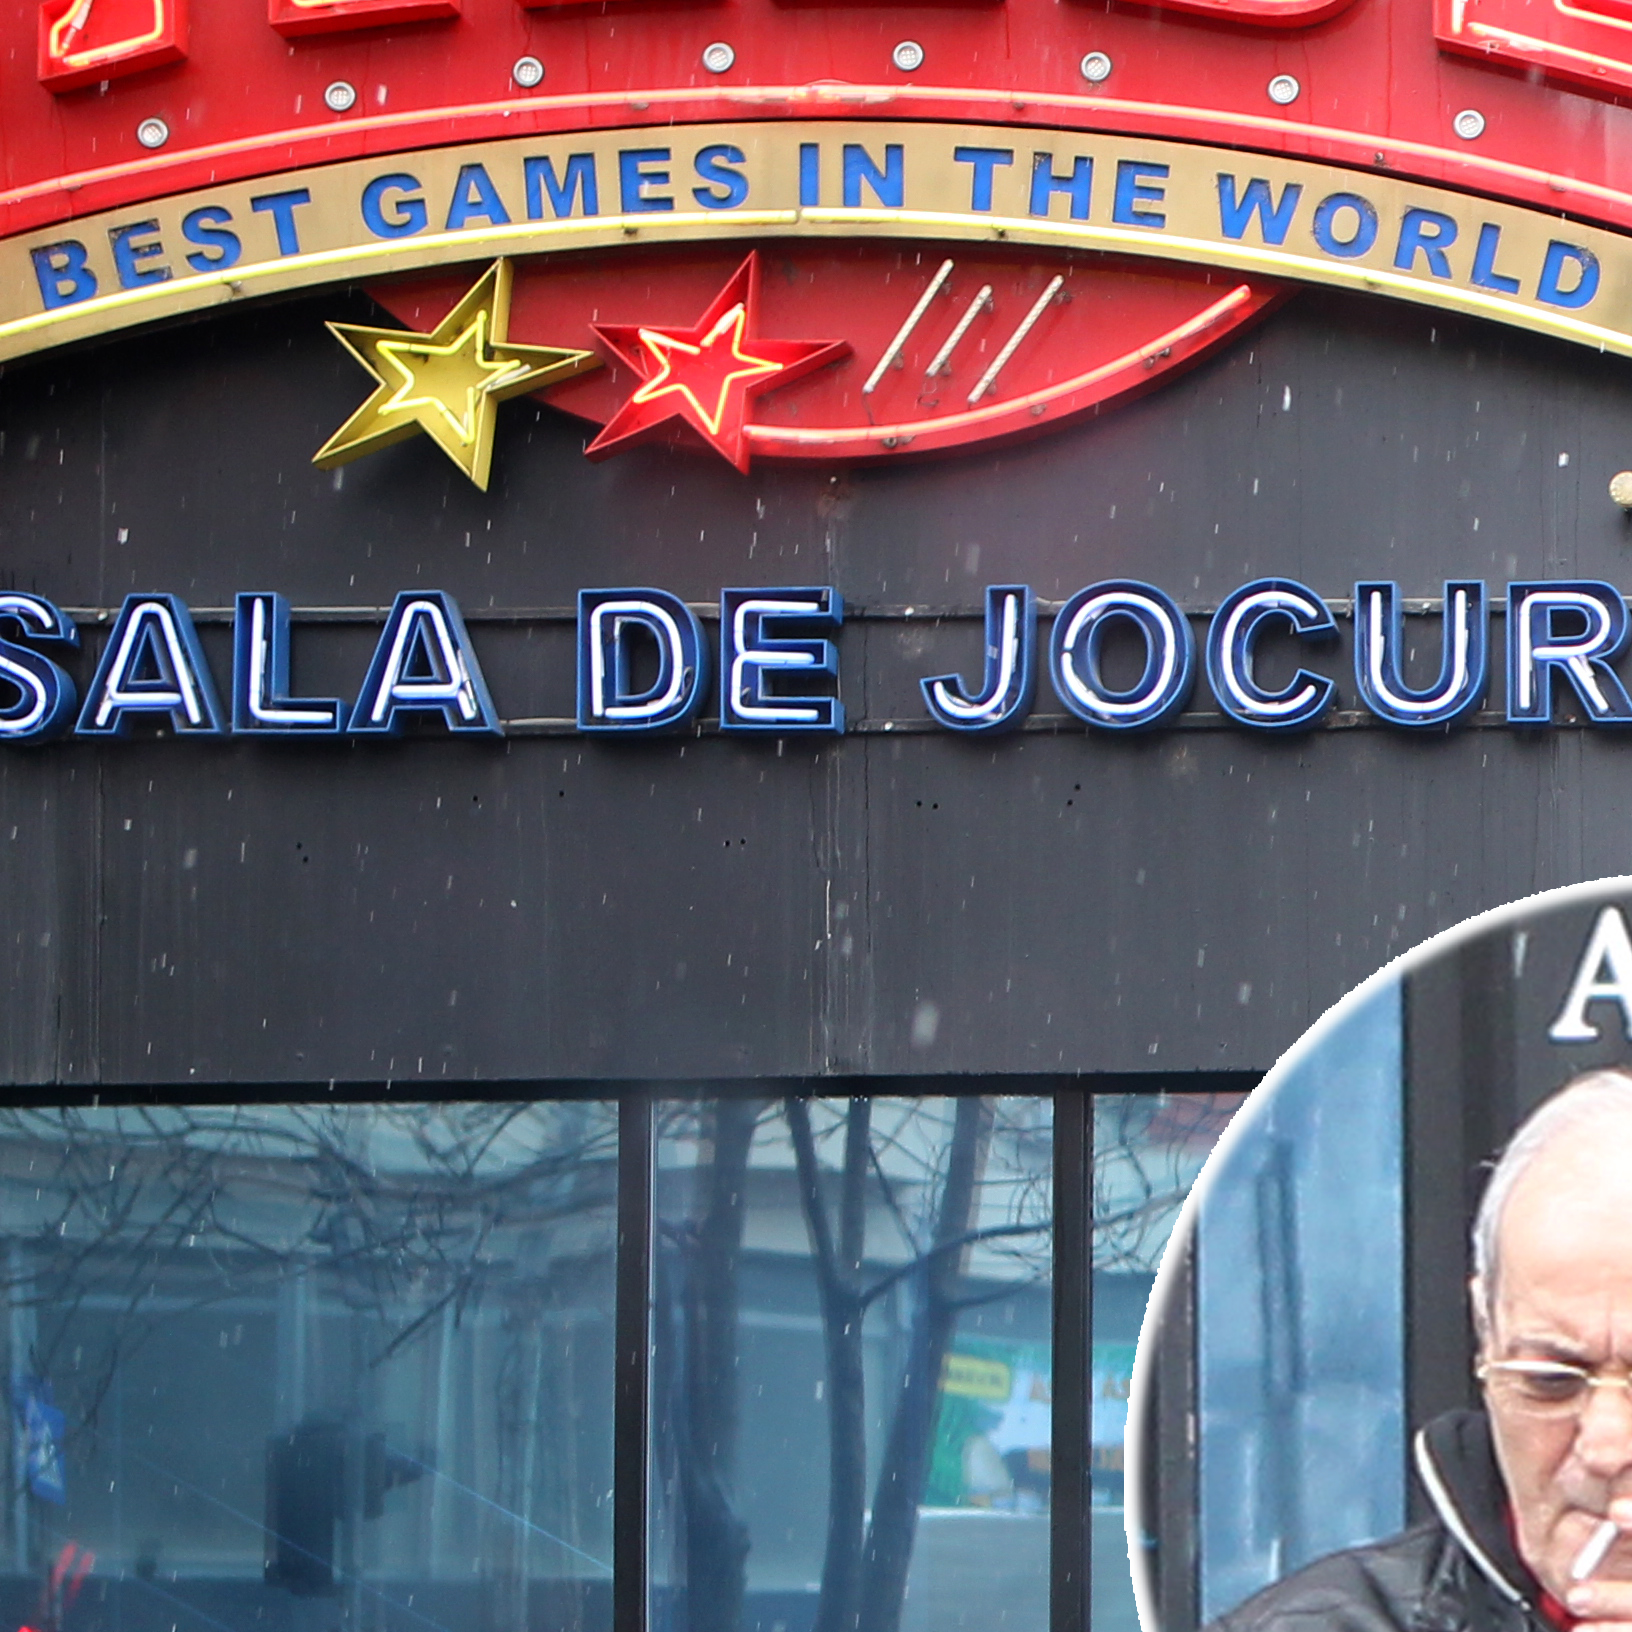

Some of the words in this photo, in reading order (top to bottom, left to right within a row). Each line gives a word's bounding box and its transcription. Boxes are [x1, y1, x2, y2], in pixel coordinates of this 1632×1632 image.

[30, 188, 311, 311] BEST
[360, 143, 749, 240] GAMES
[799, 143, 905, 208] IN
[953, 147, 1171, 228] THE
[1216, 172, 1602, 309] WORLD
[0, 589, 505, 739] SALA
[576, 586, 845, 735] DE
